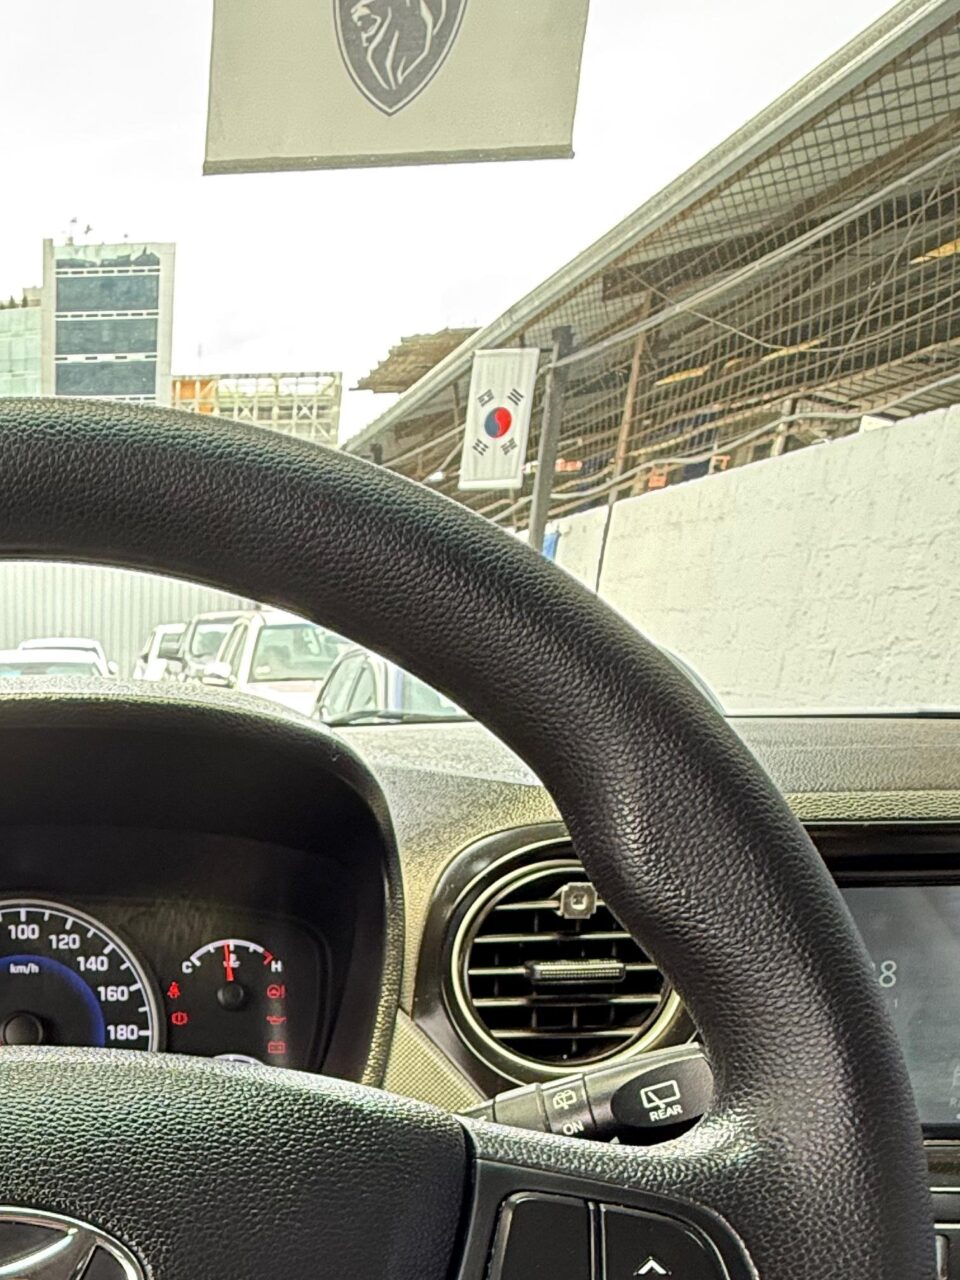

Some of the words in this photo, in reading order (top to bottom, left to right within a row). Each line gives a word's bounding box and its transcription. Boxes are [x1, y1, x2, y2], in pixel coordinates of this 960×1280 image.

[8, 924, 39, 940] 100
[49, 934, 80, 950] 120
[9, 963, 40, 975] km/h
[77, 956, 108, 972] 140
[182, 961, 193, 974] C
[271, 960, 282, 973] H
[871, 960, 897, 988] 8
[97, 985, 129, 1001] 160
[106, 1025, 138, 1041] 180
[649, 1104, 684, 1122] REAR
[562, 1120, 585, 1137] ON
